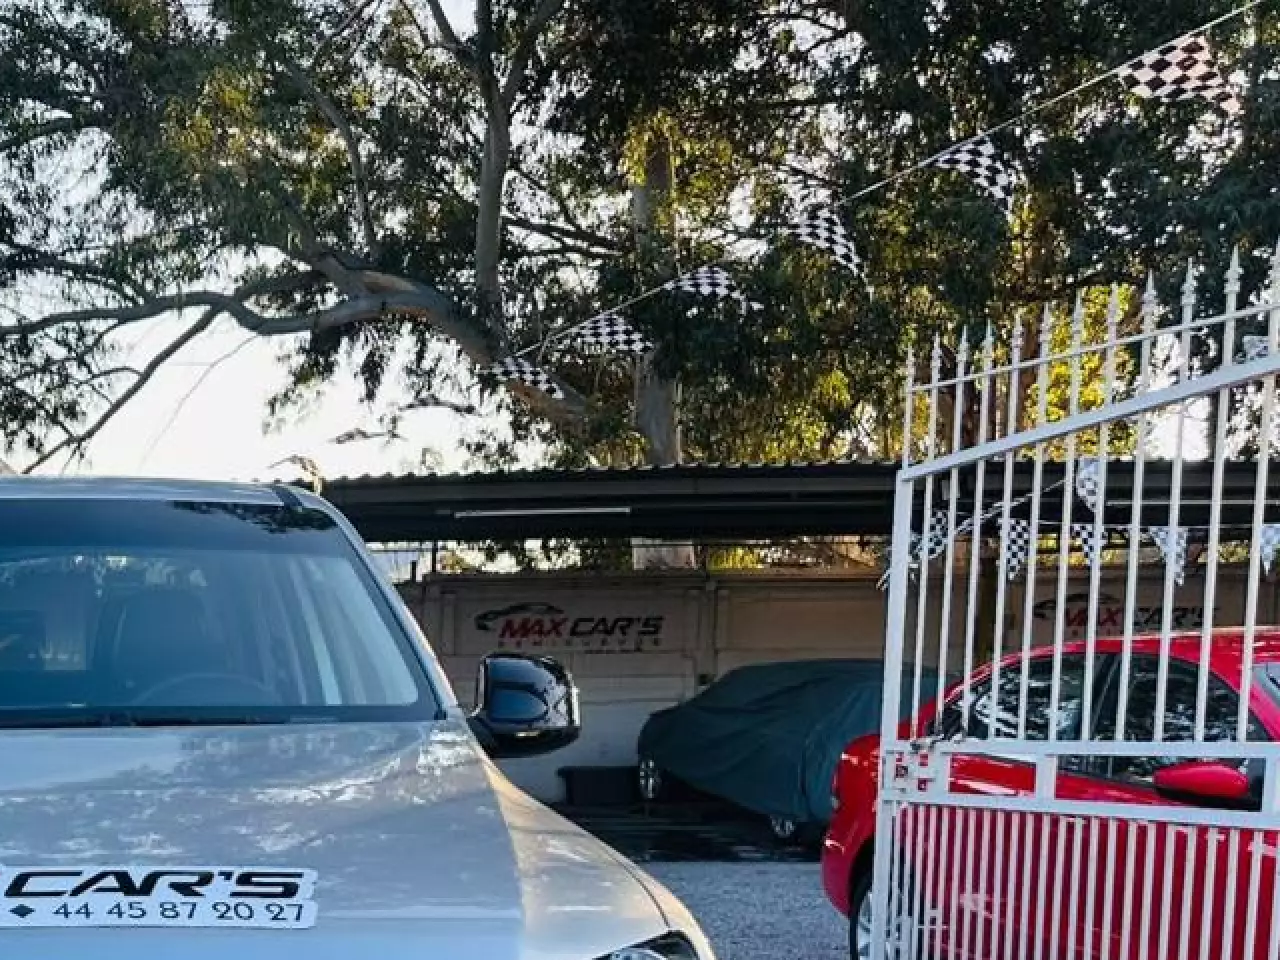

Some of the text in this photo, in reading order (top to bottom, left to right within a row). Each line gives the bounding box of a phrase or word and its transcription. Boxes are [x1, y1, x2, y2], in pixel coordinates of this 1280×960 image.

[500, 616, 665, 637] MAX CAR'S
[4, 870, 305, 899] CAR'S
[52, 901, 94, 919] 44
[106, 901, 147, 919] 45
[159, 902, 197, 919] 87
[212, 901, 254, 920] 20
[265, 903, 304, 921] 27
